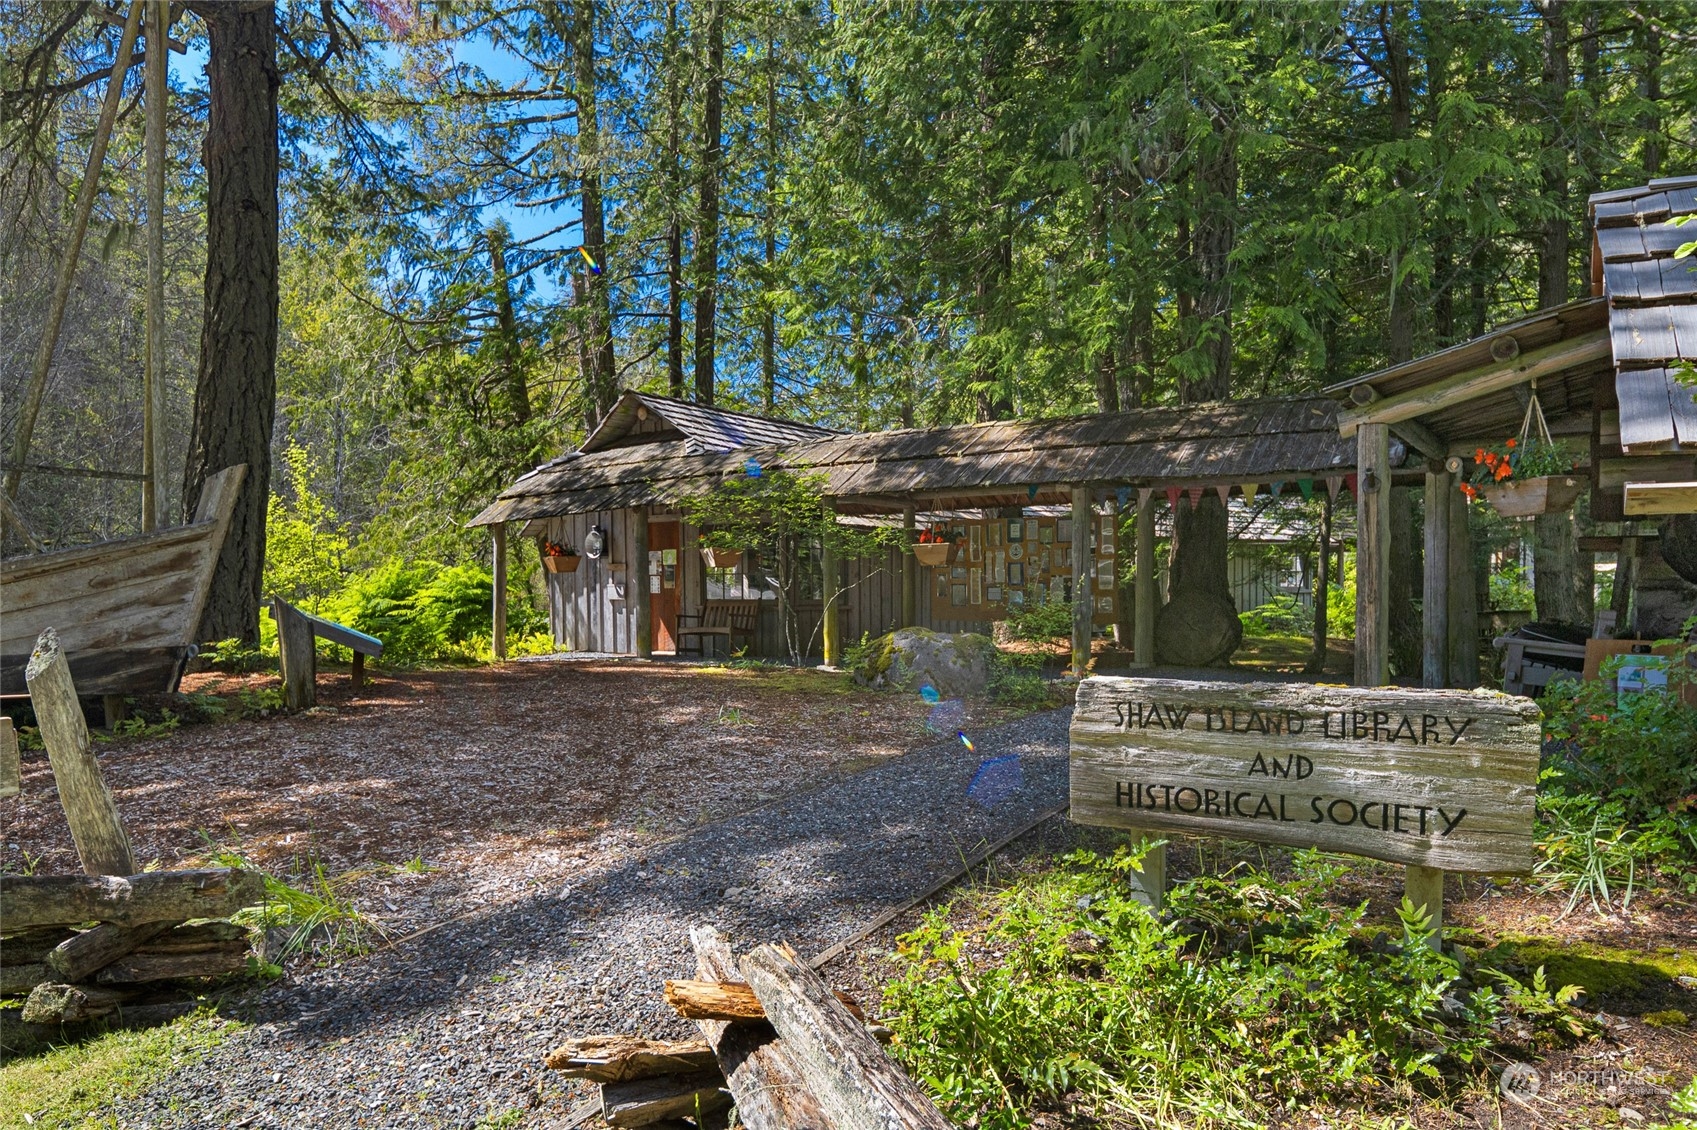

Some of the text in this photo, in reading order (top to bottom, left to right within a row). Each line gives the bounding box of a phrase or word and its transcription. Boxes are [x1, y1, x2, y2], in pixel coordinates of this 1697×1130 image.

[1114, 701, 1474, 745] SHAW ISLAND LIBRARY
[1247, 751, 1314, 780] AND
[1115, 781, 1468, 836] HISTORICAL SOCIETY
